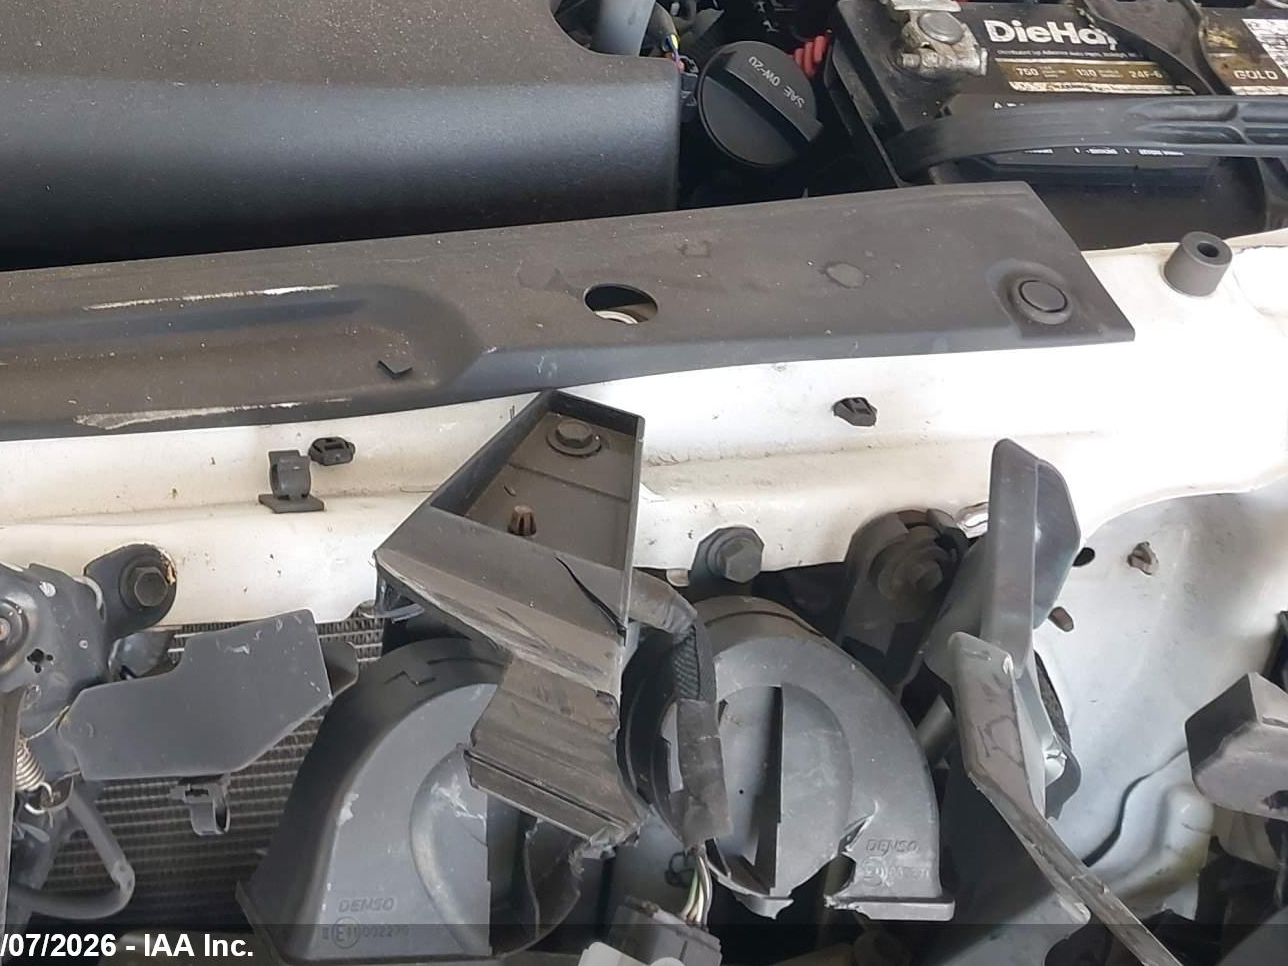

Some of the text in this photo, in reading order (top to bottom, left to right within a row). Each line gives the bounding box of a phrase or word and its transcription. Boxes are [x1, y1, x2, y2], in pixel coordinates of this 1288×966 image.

[1015, 66, 1040, 77] 750
[1233, 69, 1279, 80] GOLD
[748, 55, 806, 109] SAE 0W-20
[865, 838, 919, 855] DENSO
[337, 896, 397, 914] DENSO
